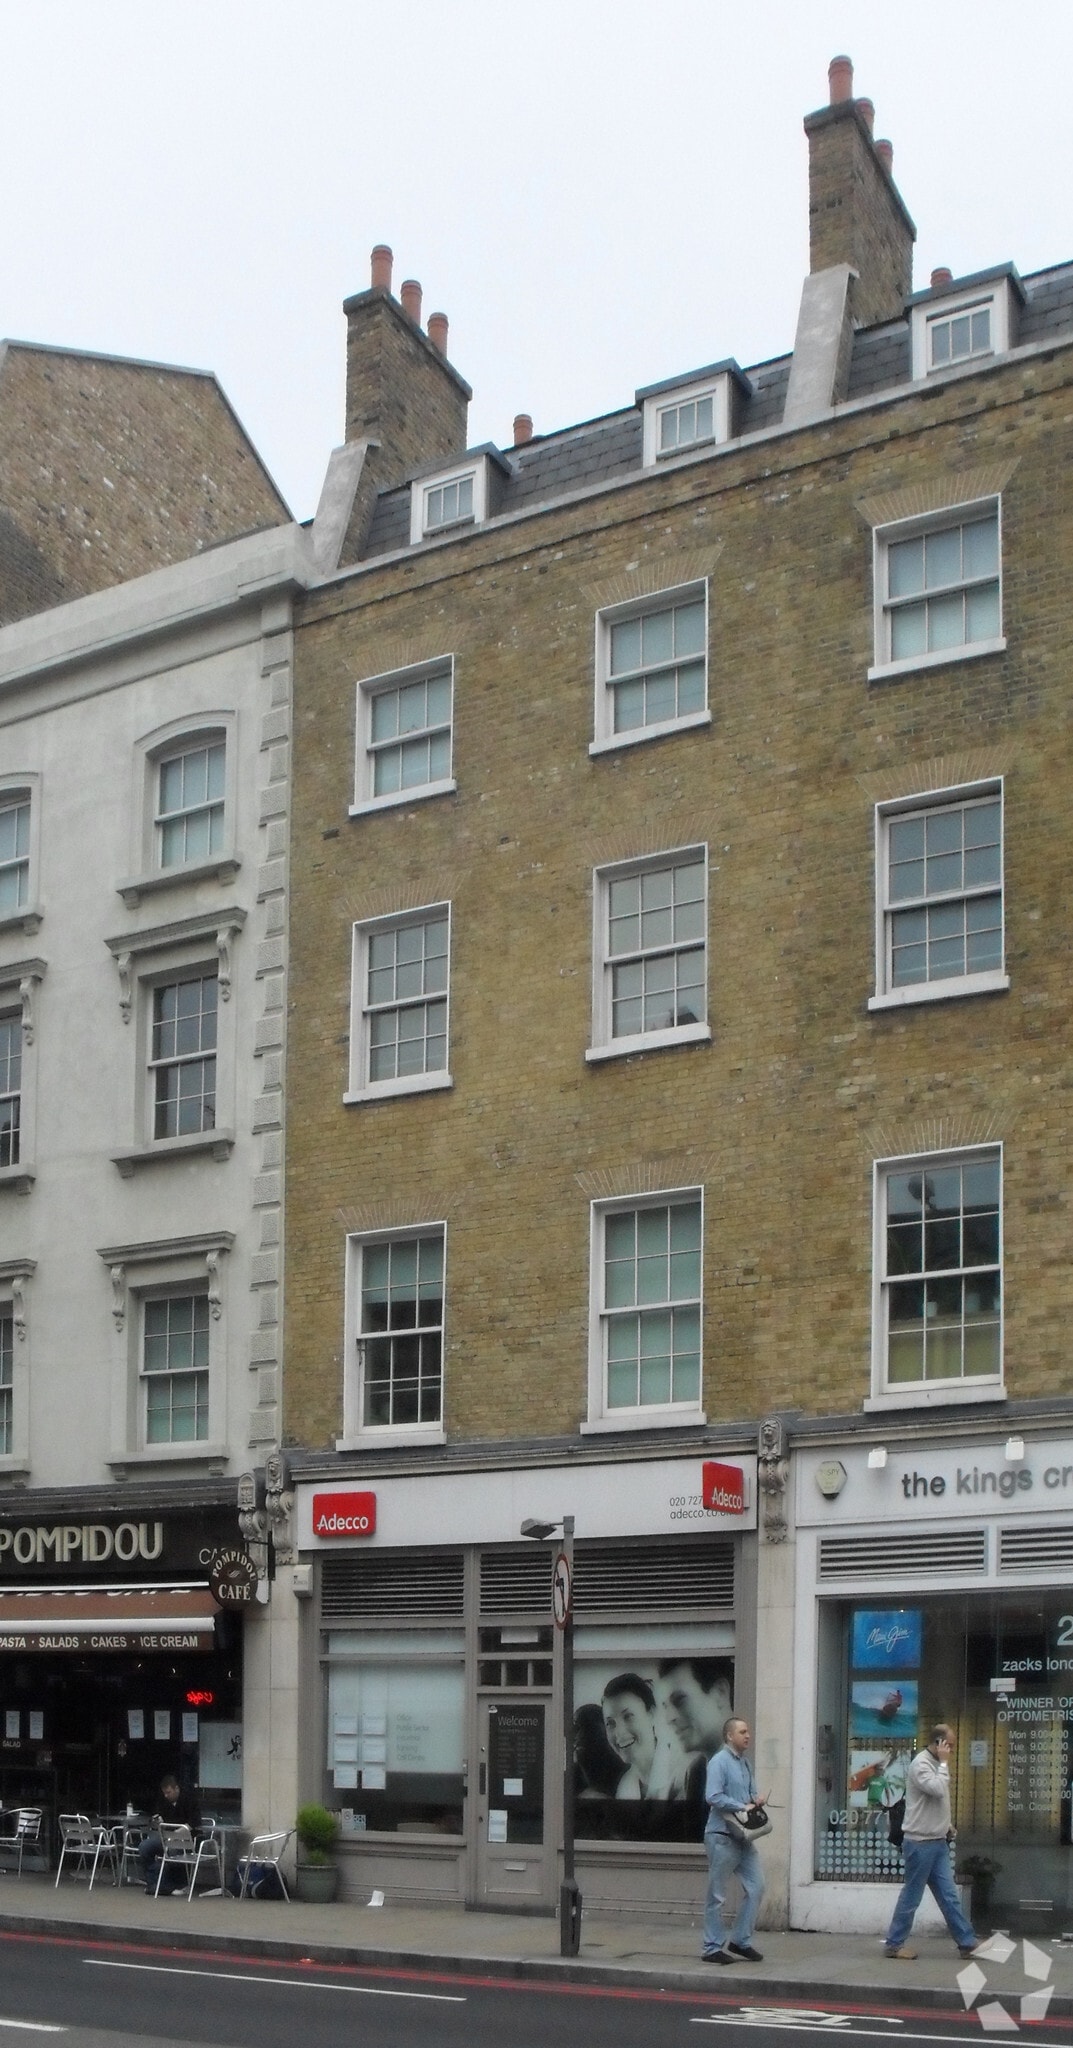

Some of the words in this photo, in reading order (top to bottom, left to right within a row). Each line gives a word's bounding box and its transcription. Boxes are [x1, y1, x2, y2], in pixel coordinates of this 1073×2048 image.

[902, 1472, 946, 1498] the
[956, 1467, 1033, 1498] kings
[669, 1496, 686, 1507] 020
[711, 1486, 742, 1510] Adecco
[316, 1513, 369, 1531] Adecco
[0, 1522, 163, 1564] POMPIDOU
[212, 1551, 257, 1580] POMPIDOU
[218, 1582, 251, 1601] CAFÉ
[38, 1636, 80, 1648] SALADS
[90, 1636, 127, 1648] CAKES
[140, 1636, 158, 1648] ICE
[159, 1635, 198, 1648] CREAM
[1002, 1658, 1042, 1672] zacks
[1005, 1697, 1053, 1708] WINNER
[498, 1715, 539, 1727] Welcome
[1008, 1730, 1027, 1739] Mon
[1009, 1742, 1025, 1751] Tue
[1009, 1754, 1027, 1763] Wed
[1009, 1766, 1024, 1775] Thu
[1008, 1778, 1018, 1787] Fri
[1008, 1790, 1021, 1799] Sat
[1008, 1802, 1024, 1811] Sun
[830, 1810, 859, 1825] 020
